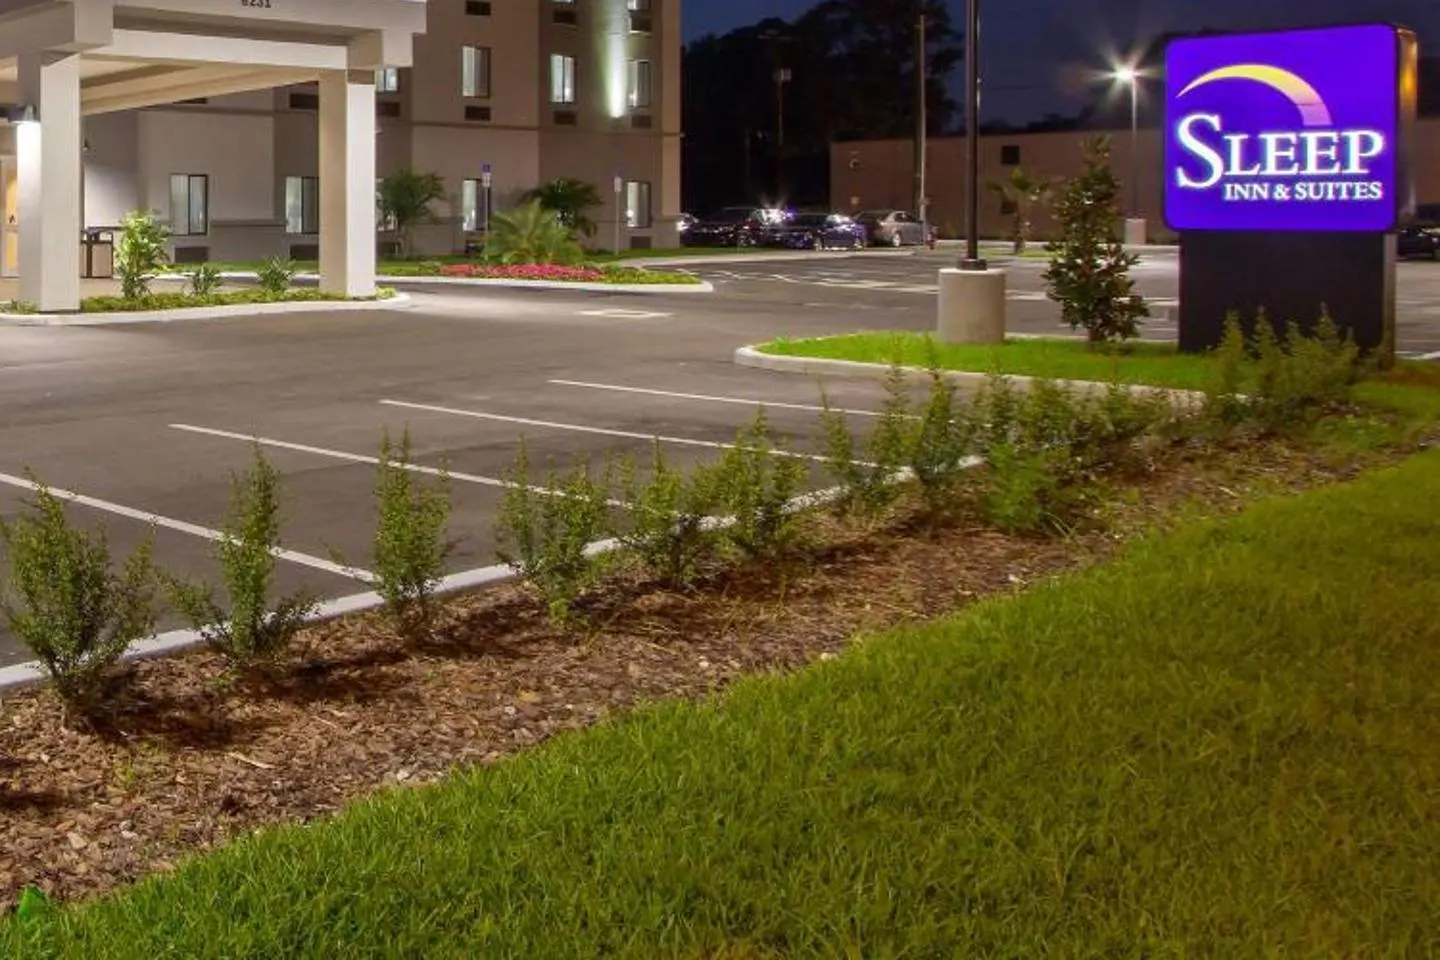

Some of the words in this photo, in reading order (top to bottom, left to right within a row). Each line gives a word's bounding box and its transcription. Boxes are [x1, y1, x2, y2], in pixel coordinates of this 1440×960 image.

[1175, 112, 1385, 189] SLEEP
[1223, 182, 1270, 201] INN
[1273, 182, 1291, 201] &
[1294, 181, 1384, 201] SUITES
